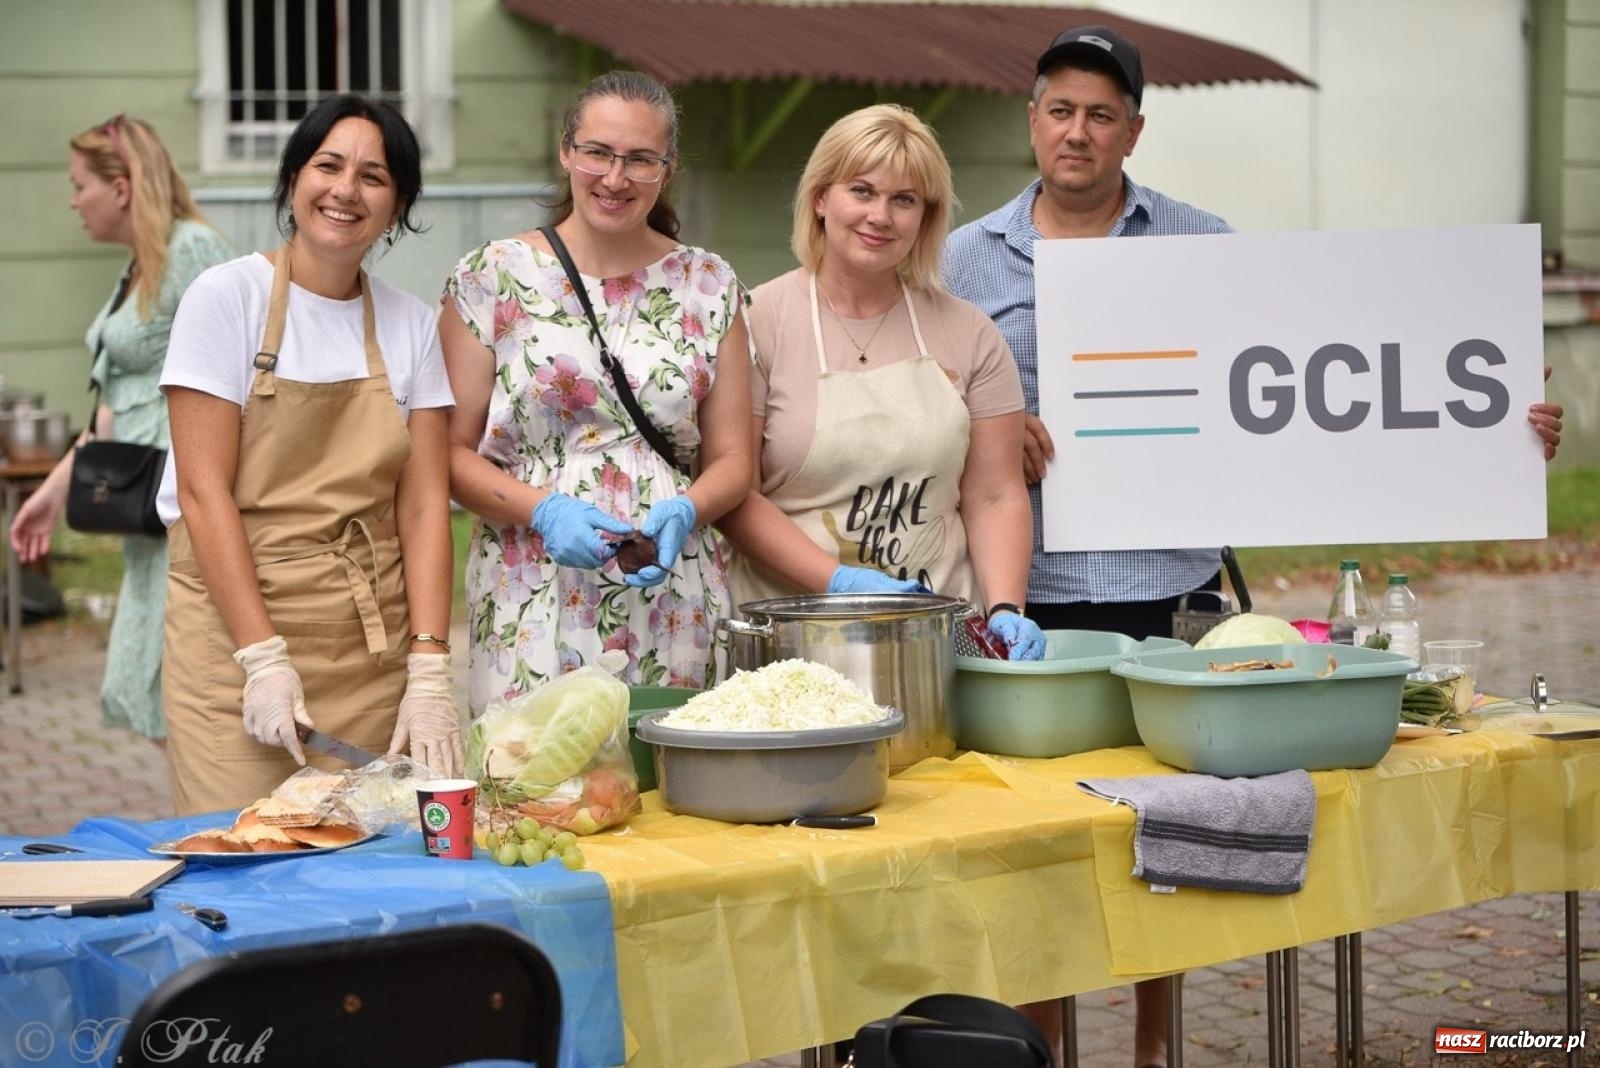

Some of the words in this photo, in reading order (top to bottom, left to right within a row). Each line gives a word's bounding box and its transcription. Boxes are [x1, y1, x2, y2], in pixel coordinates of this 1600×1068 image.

[1229, 339, 1510, 434] GCLS
[847, 476, 936, 533] BAKE
[855, 525, 908, 569] the
